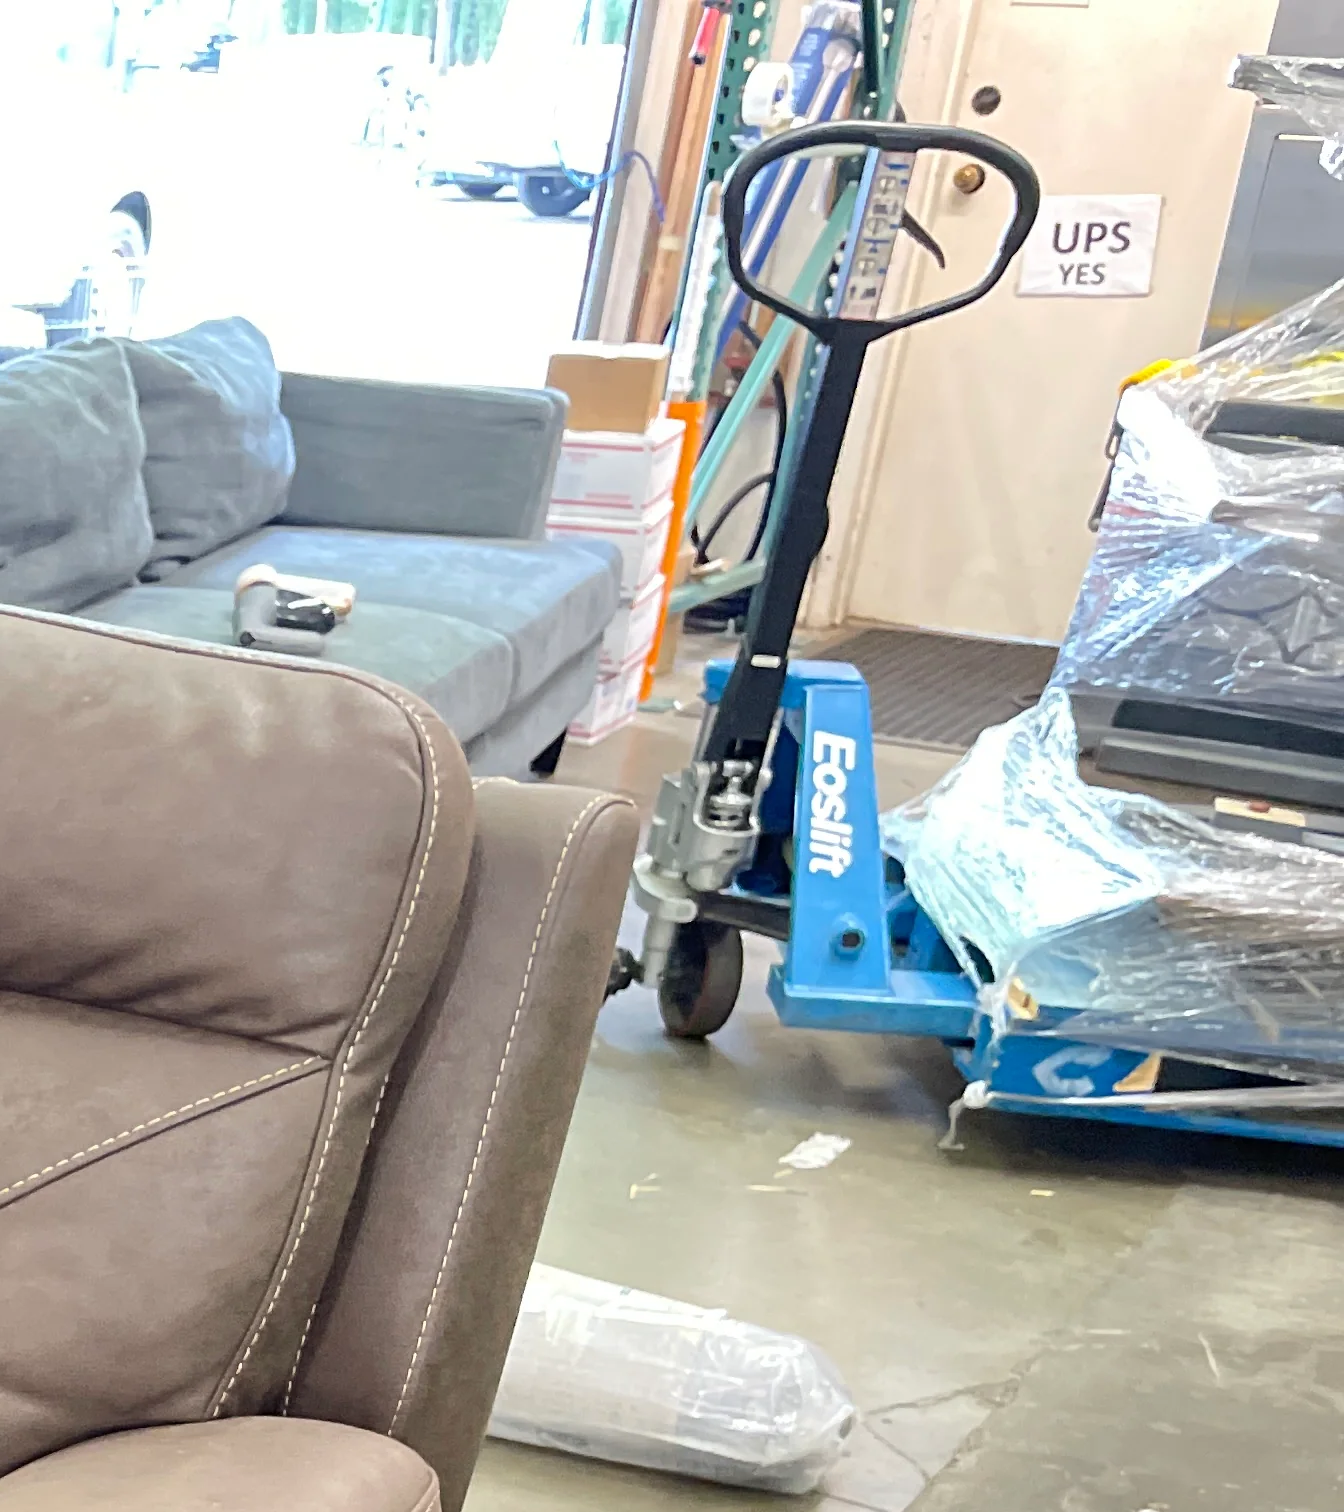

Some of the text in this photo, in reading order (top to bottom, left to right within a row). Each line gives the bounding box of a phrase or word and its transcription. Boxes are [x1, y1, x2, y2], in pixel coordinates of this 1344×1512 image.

[1052, 221, 1132, 254] UPS
[1058, 263, 1107, 286] YES
[808, 730, 857, 879] Eoslift
